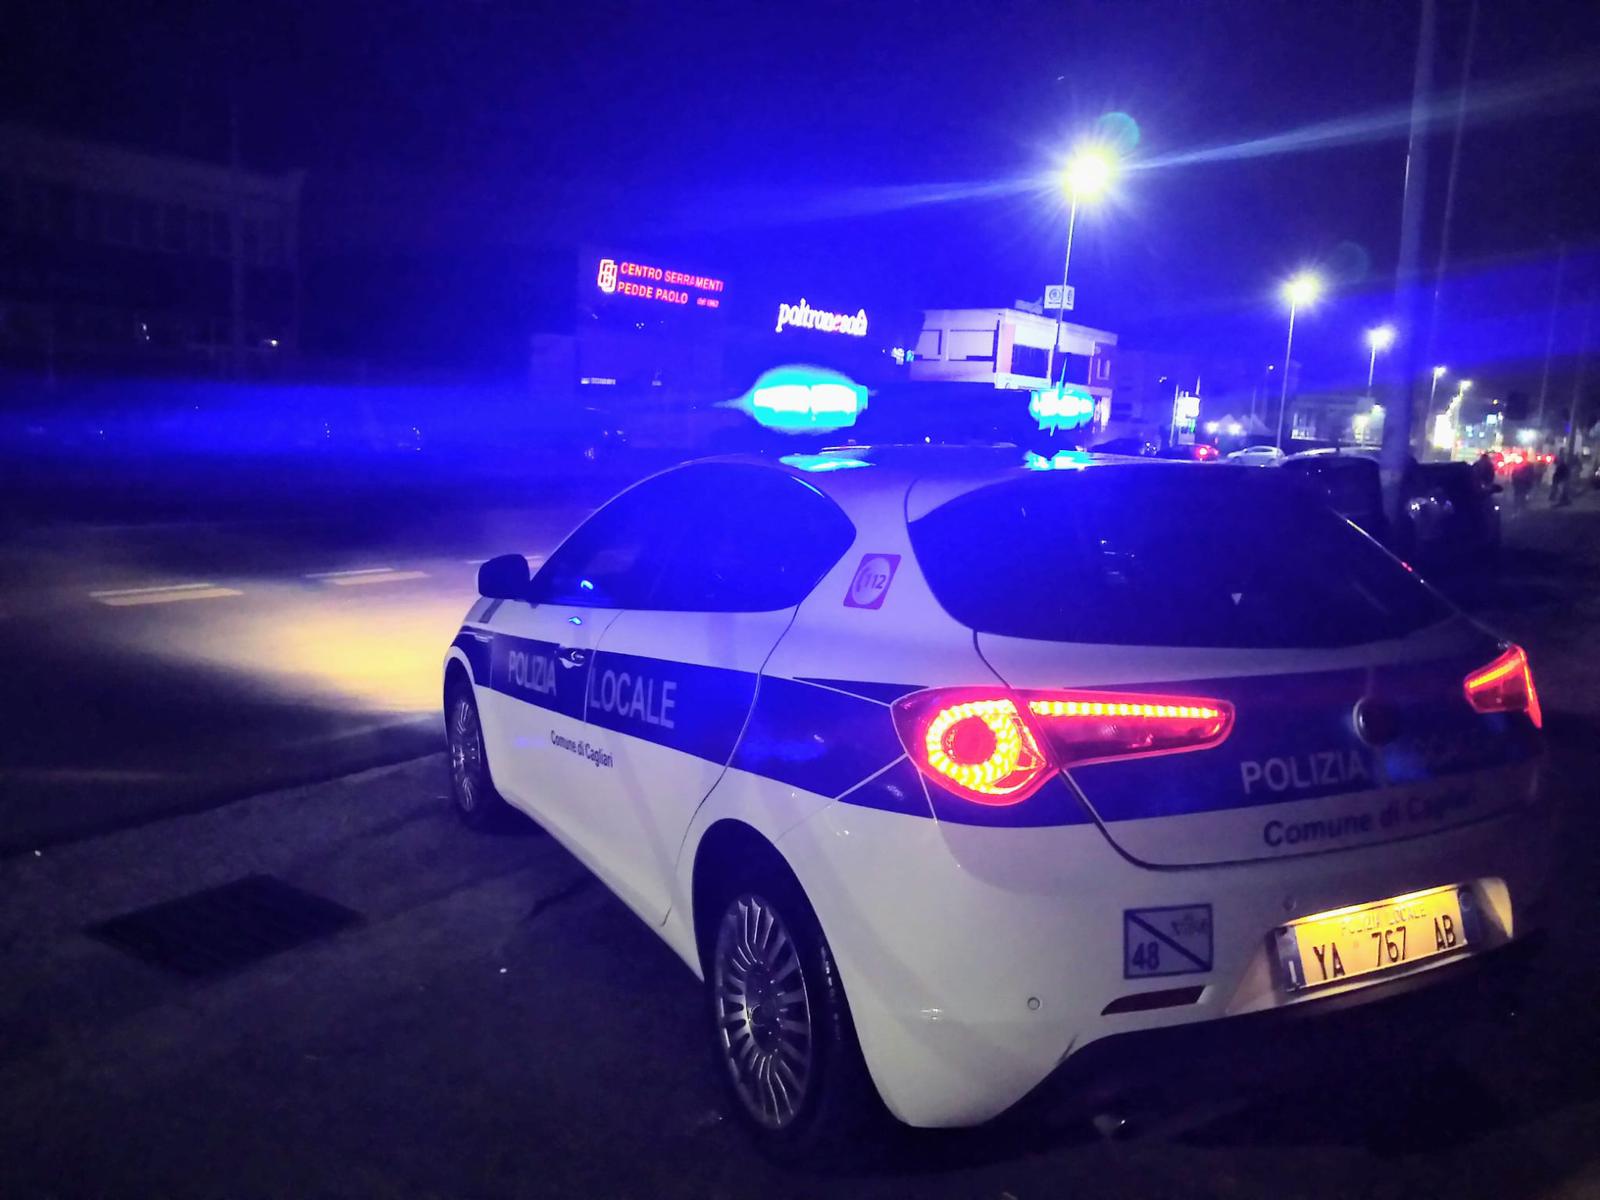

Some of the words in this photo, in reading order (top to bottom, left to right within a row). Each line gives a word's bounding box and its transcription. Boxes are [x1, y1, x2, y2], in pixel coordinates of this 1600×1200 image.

[617, 281, 653, 299] PEDDE
[655, 288, 689, 305] PAOLO
[620, 262, 663, 281] CENTRO
[664, 270, 724, 292] SERRAMENTI
[508, 651, 557, 696] POLIZIA
[590, 669, 677, 729] LOCALE
[551, 730, 577, 754] Comune
[577, 740, 585, 757] di
[584, 743, 614, 768] Cagliari
[1240, 751, 1367, 794] POLIZIA
[1264, 813, 1371, 847] Comune
[1380, 800, 1400, 828] di
[1132, 941, 1160, 971] 48
[1313, 941, 1346, 981] YA
[1371, 926, 1407, 968] 767
[1434, 914, 1457, 952] AB
